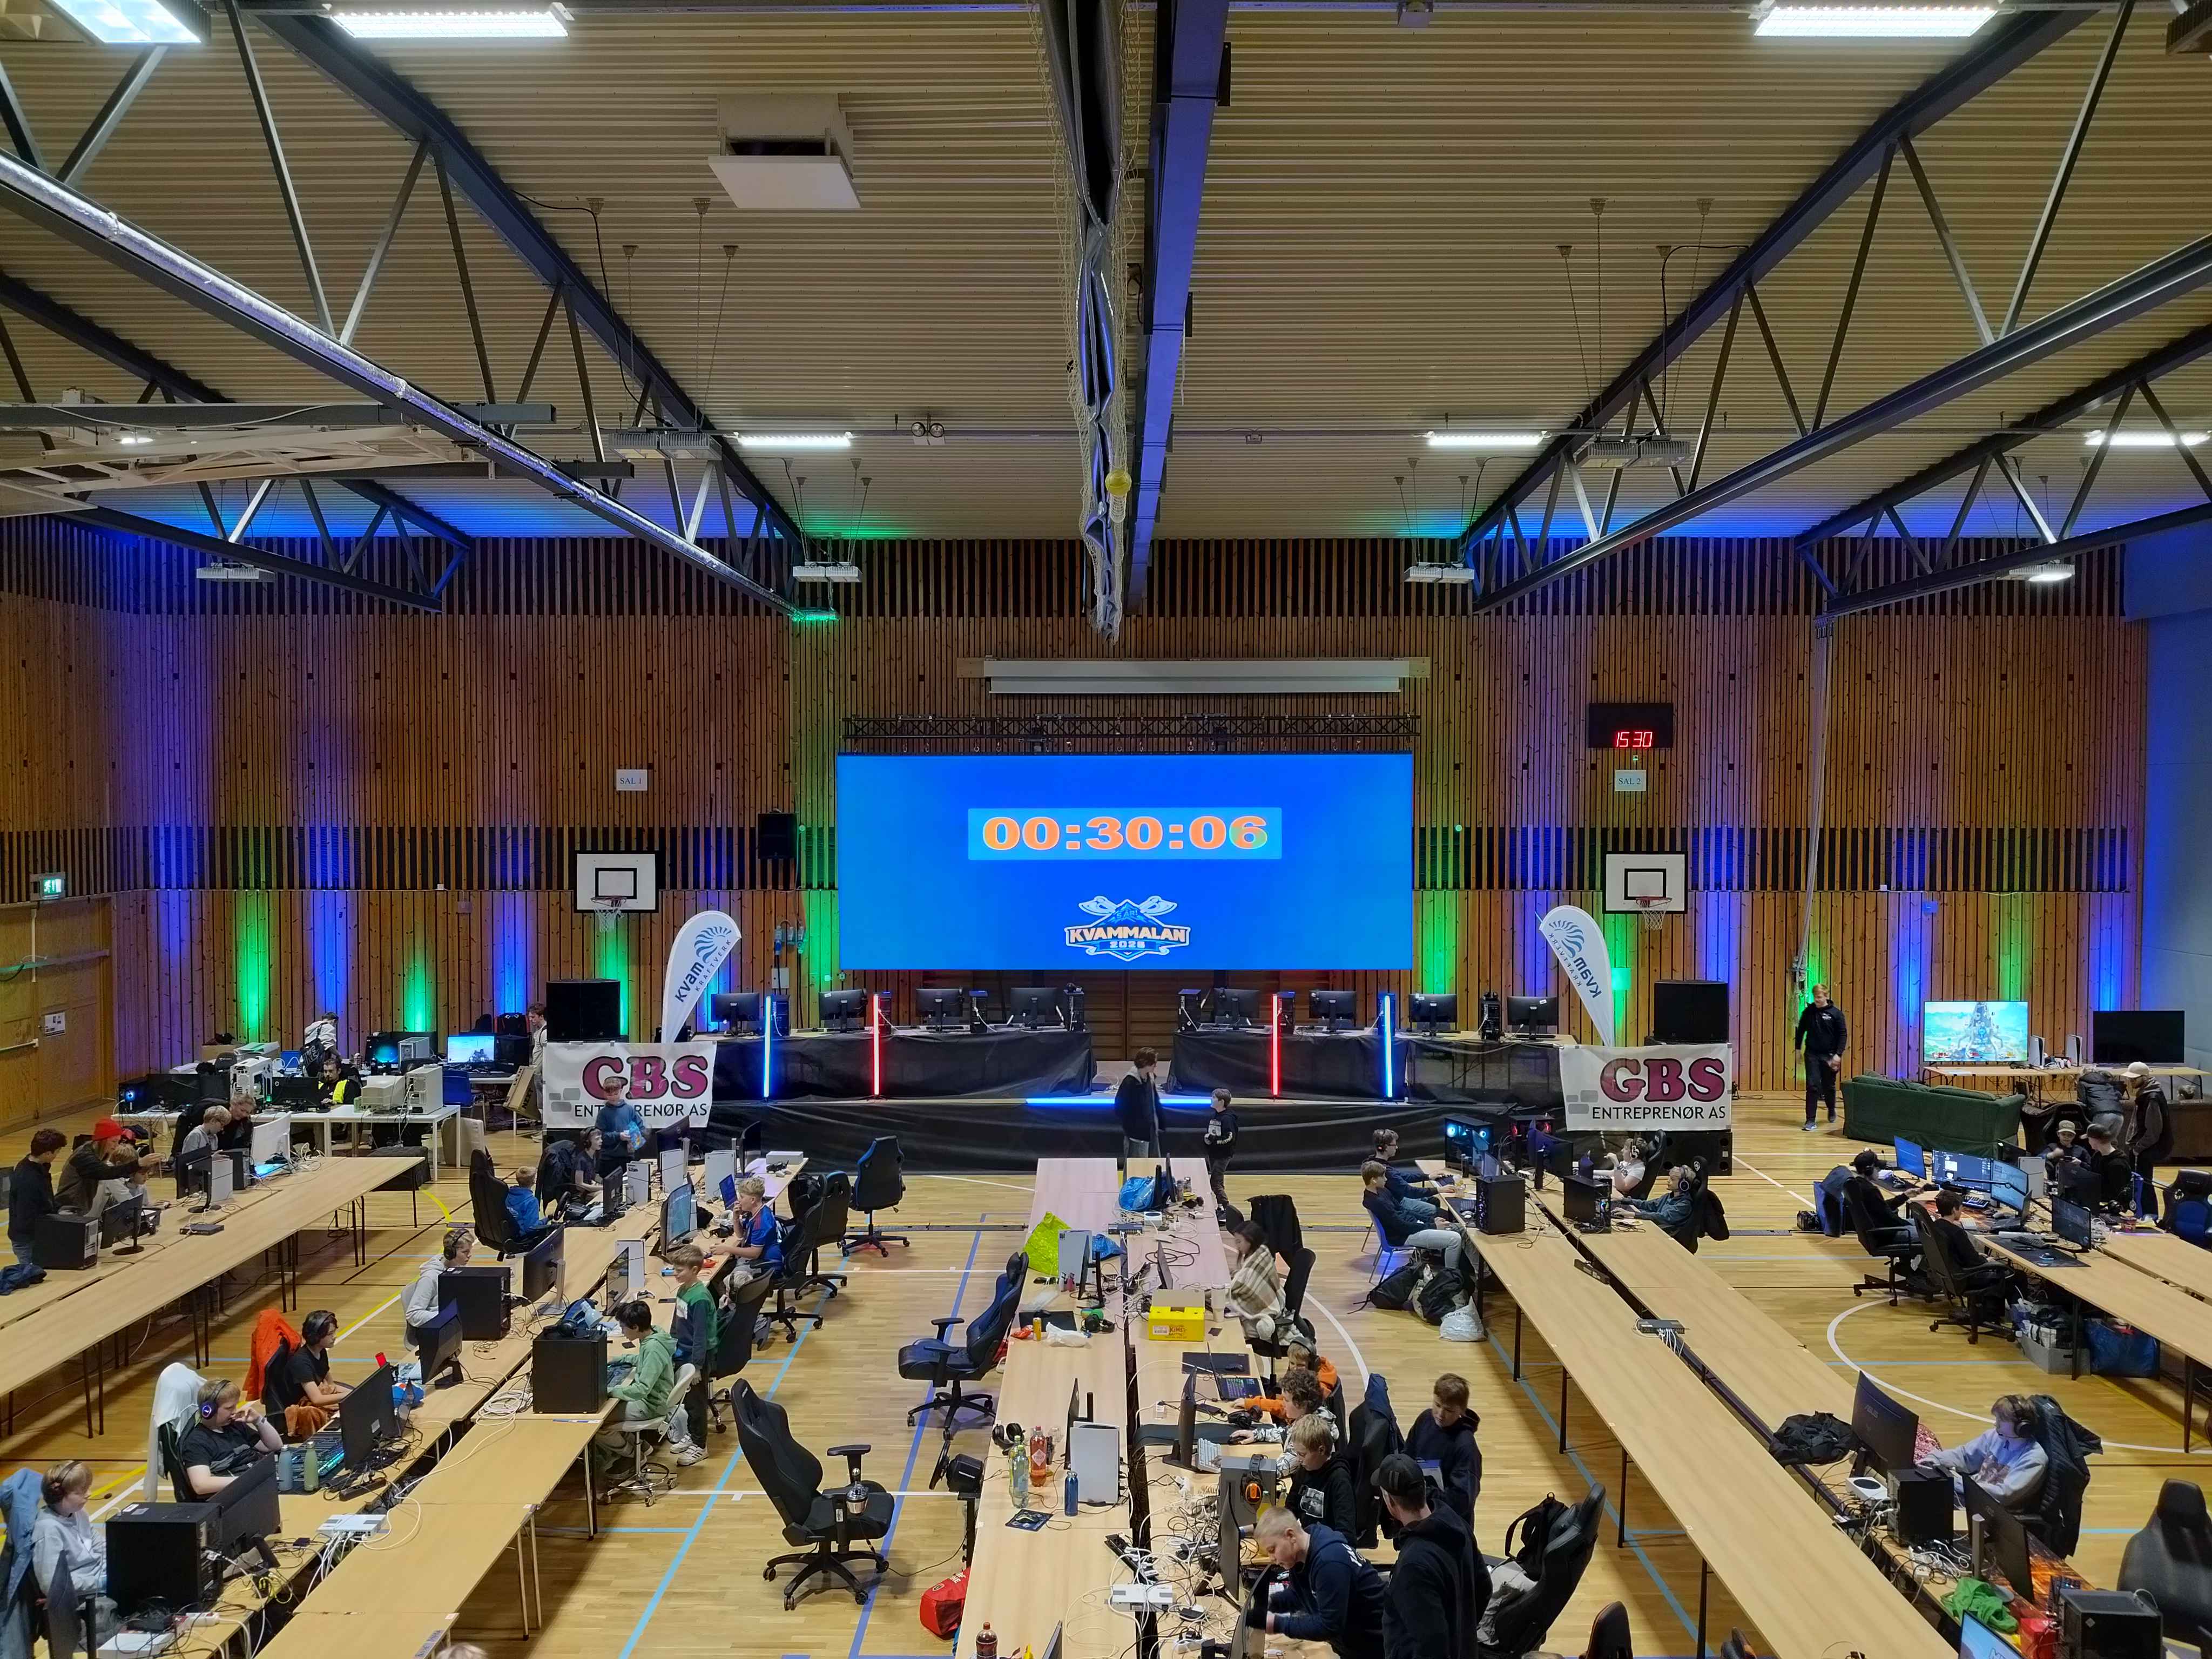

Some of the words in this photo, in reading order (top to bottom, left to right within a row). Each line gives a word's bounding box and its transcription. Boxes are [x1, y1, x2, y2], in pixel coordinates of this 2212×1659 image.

[983, 815, 1268, 851] 00:30:06
[1070, 926, 1185, 943] KVAMMALAN
[695, 940, 731, 992] KRAFTVERK
[582, 1055, 708, 1100] GBS
[1600, 1057, 1725, 1103] GBS
[575, 1103, 684, 1117] ENTRENØR
[689, 1103, 707, 1116] AS
[1593, 1105, 1704, 1120] ENTREPRENØR
[1709, 1105, 1726, 1119] AS
